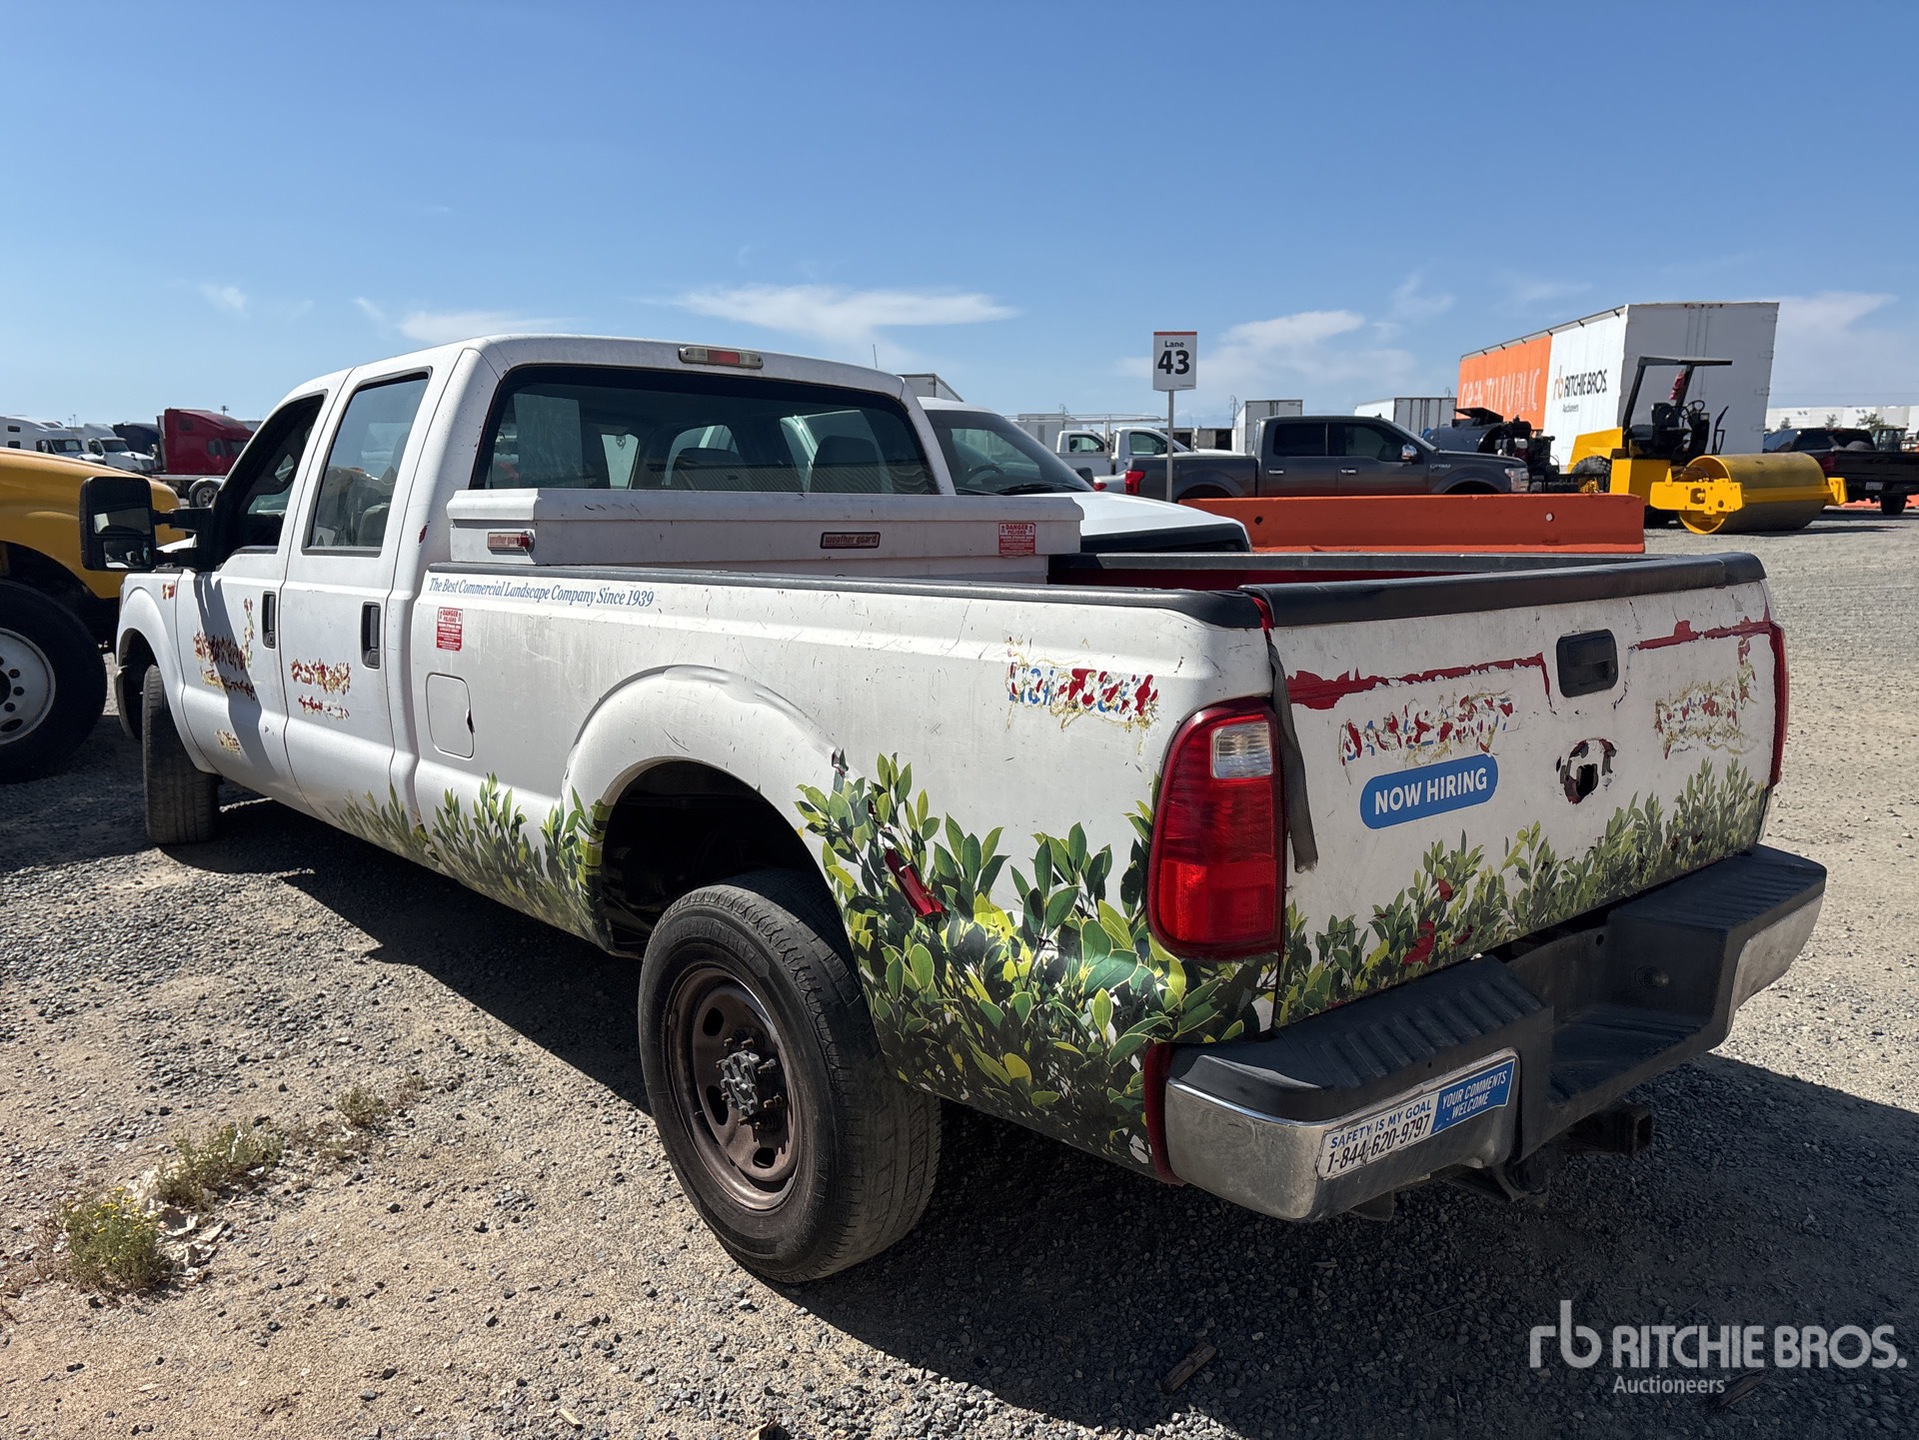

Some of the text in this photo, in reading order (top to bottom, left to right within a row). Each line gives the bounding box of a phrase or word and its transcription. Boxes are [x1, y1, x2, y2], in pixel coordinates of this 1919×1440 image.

[1164, 340, 1185, 348] Lane
[1157, 350, 1190, 375] 43
[429, 577, 655, 607] The Best Commercial Landscape Company Since 1939
[1375, 767, 1487, 815] NOW HIRING
[1442, 1070, 1507, 1110] YOUR COMMENTS
[1451, 1091, 1491, 1120] WELCOME
[1330, 1099, 1432, 1149] SAFETY IS MY GOAL
[1327, 1113, 1431, 1173] 1-844-620-9797
